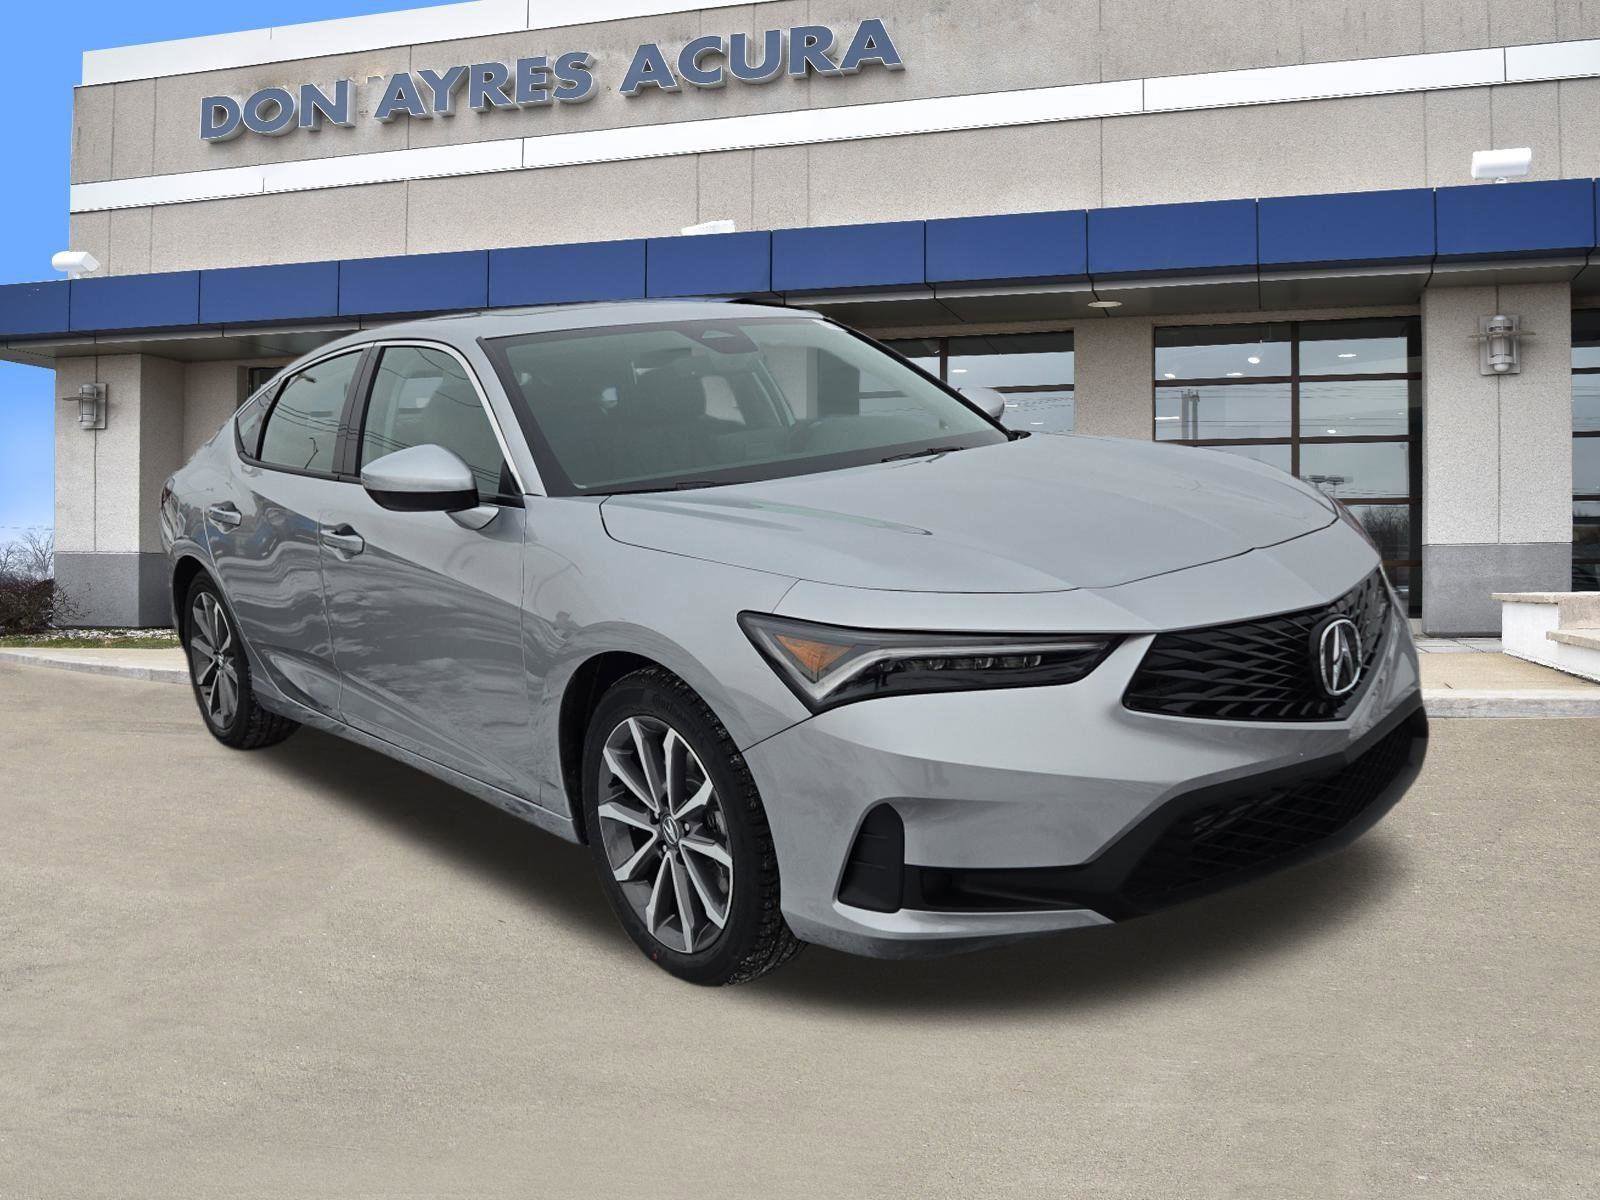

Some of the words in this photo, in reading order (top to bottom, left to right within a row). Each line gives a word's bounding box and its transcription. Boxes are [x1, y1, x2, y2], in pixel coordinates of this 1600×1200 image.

[200, 79, 354, 143] DON
[374, 51, 597, 124] AYRES
[619, 18, 905, 97] ACURA
